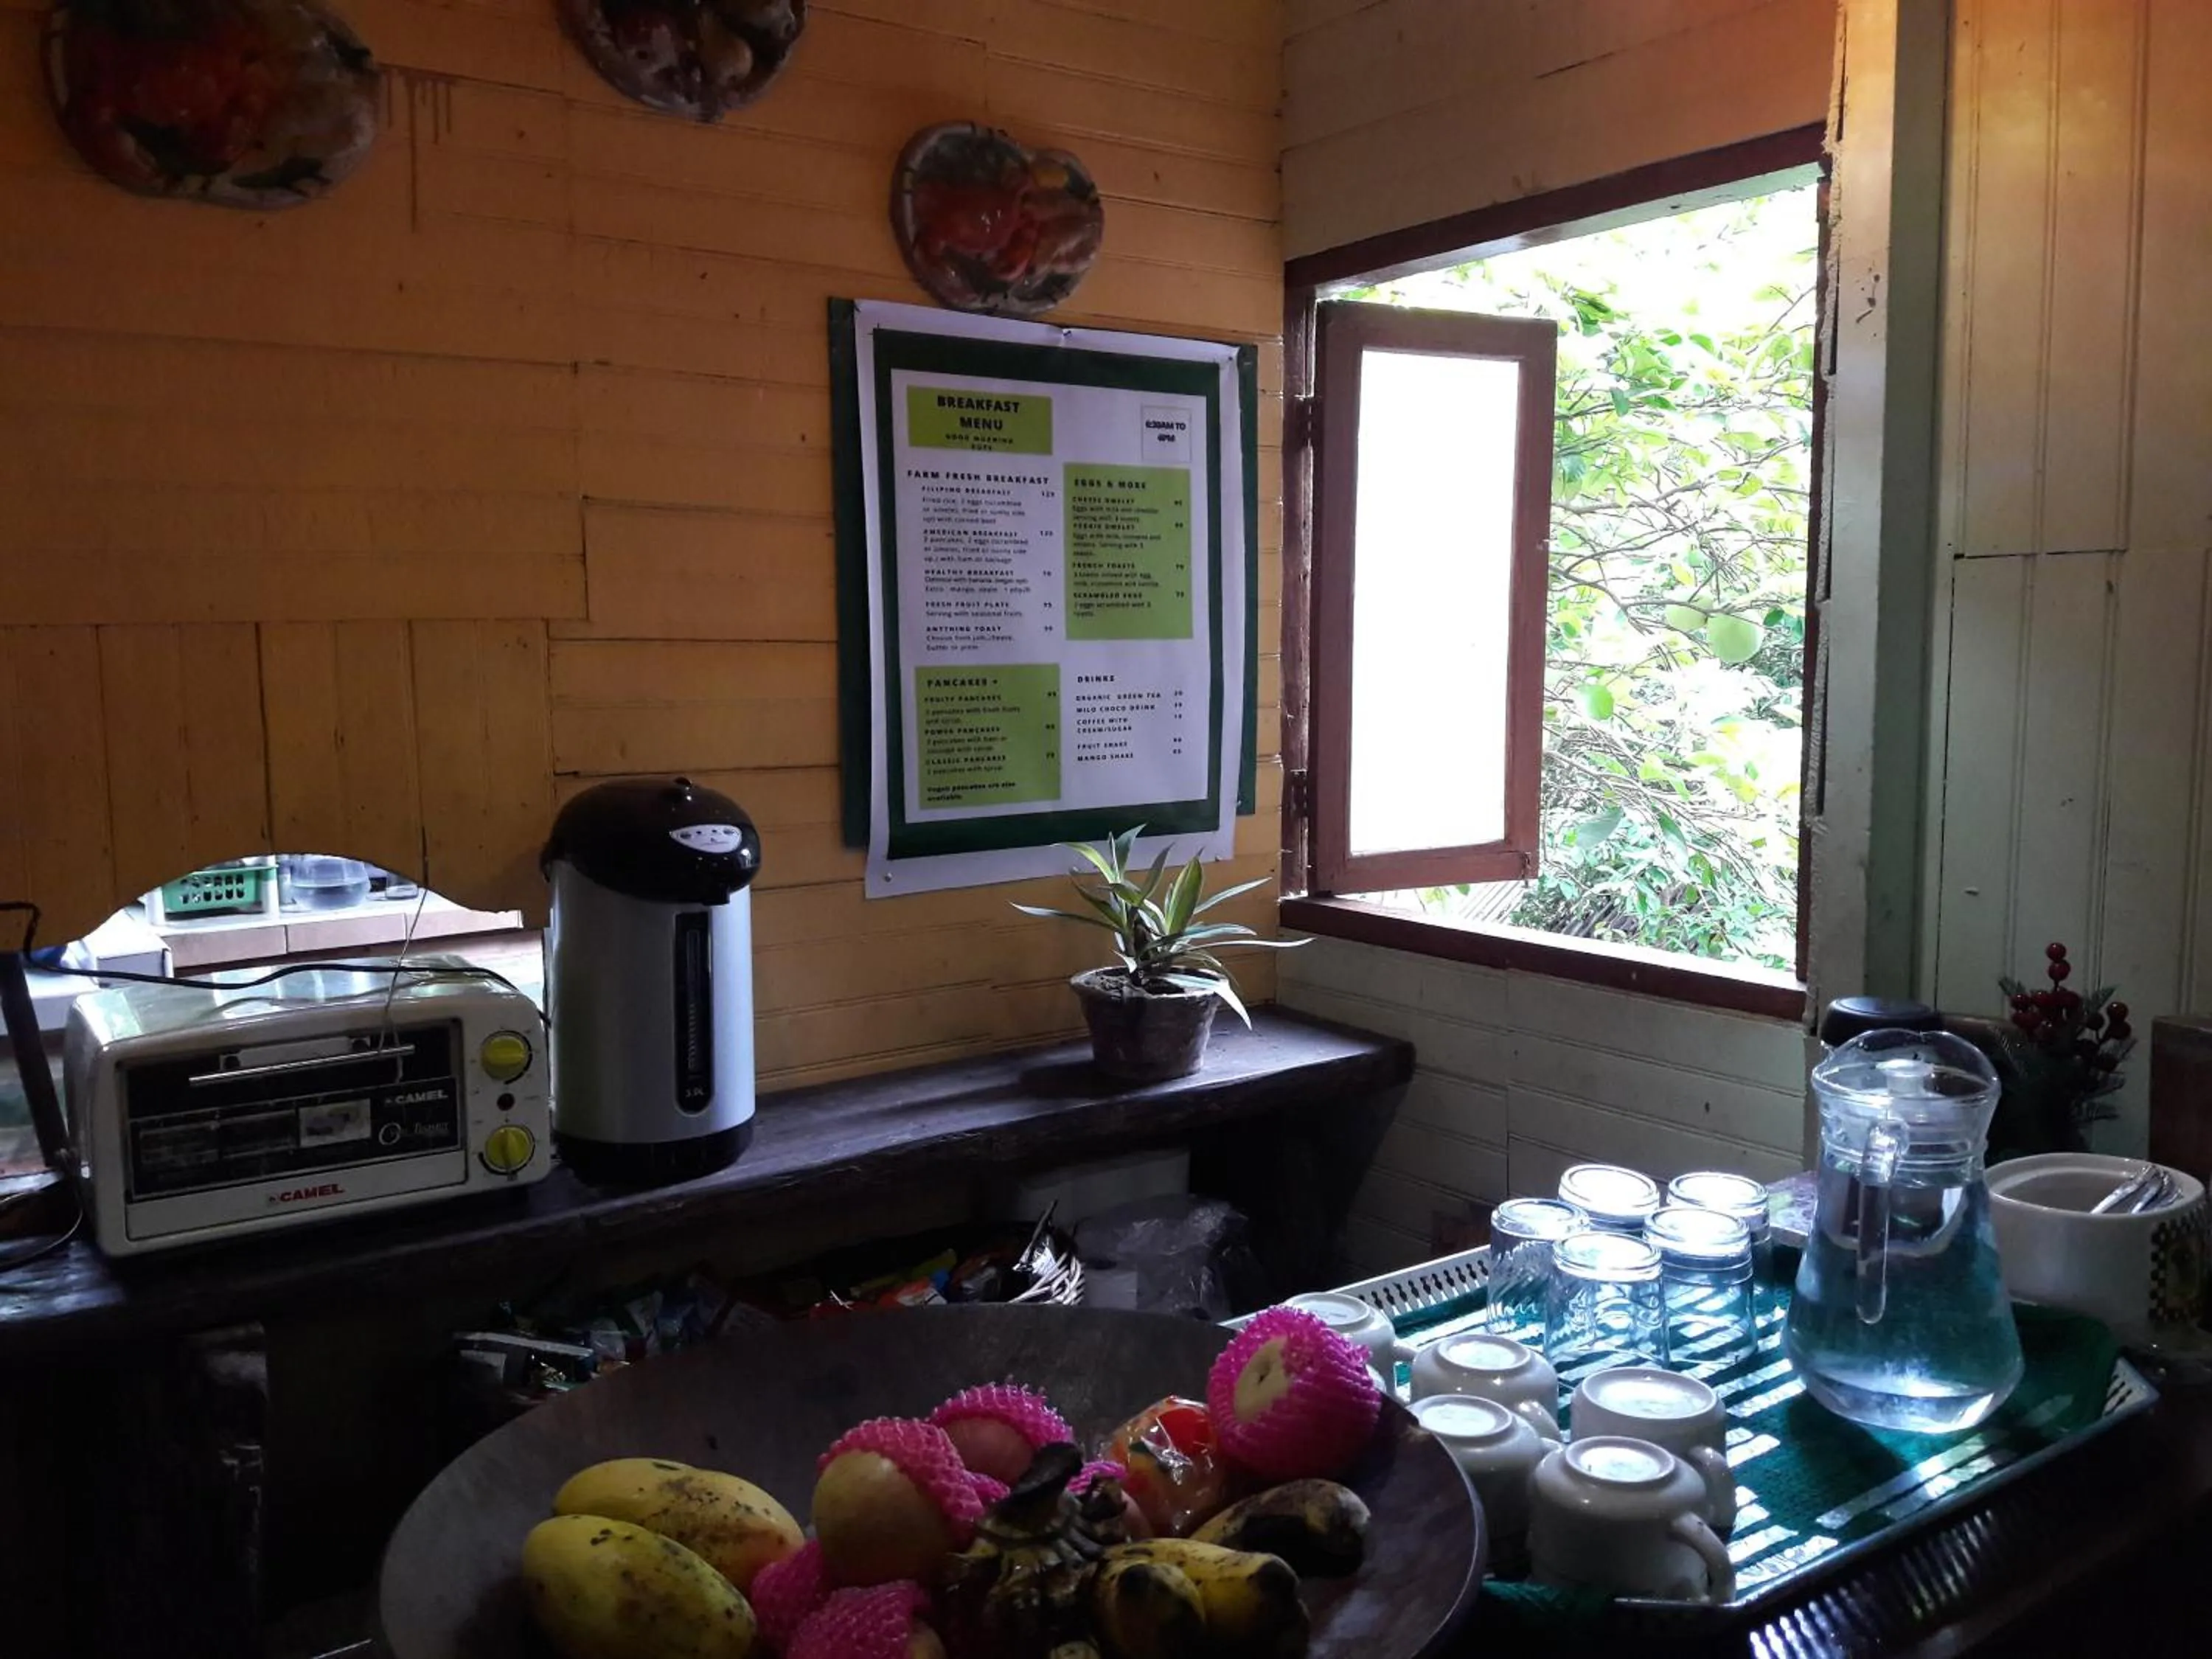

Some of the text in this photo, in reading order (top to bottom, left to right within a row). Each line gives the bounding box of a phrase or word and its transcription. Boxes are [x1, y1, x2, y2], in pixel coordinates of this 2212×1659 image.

[937, 395, 1020, 413] BREAKFAST
[959, 417, 1004, 431] MENU
[1175, 422, 1186, 431] TO
[945, 434, 1014, 444] GOOD MORNING
[908, 470, 1050, 484] FARM FRESH BREAKFAST
[1074, 479, 1101, 487] EGGS
[1119, 481, 1146, 489] MORE
[927, 678, 987, 688] PANCAKES
[1077, 726, 1132, 734] CREAM/SUGAR
[952, 784, 986, 792] pancakes
[394, 1090, 449, 1105] CAMEL
[280, 1183, 345, 1203] CAMEL
